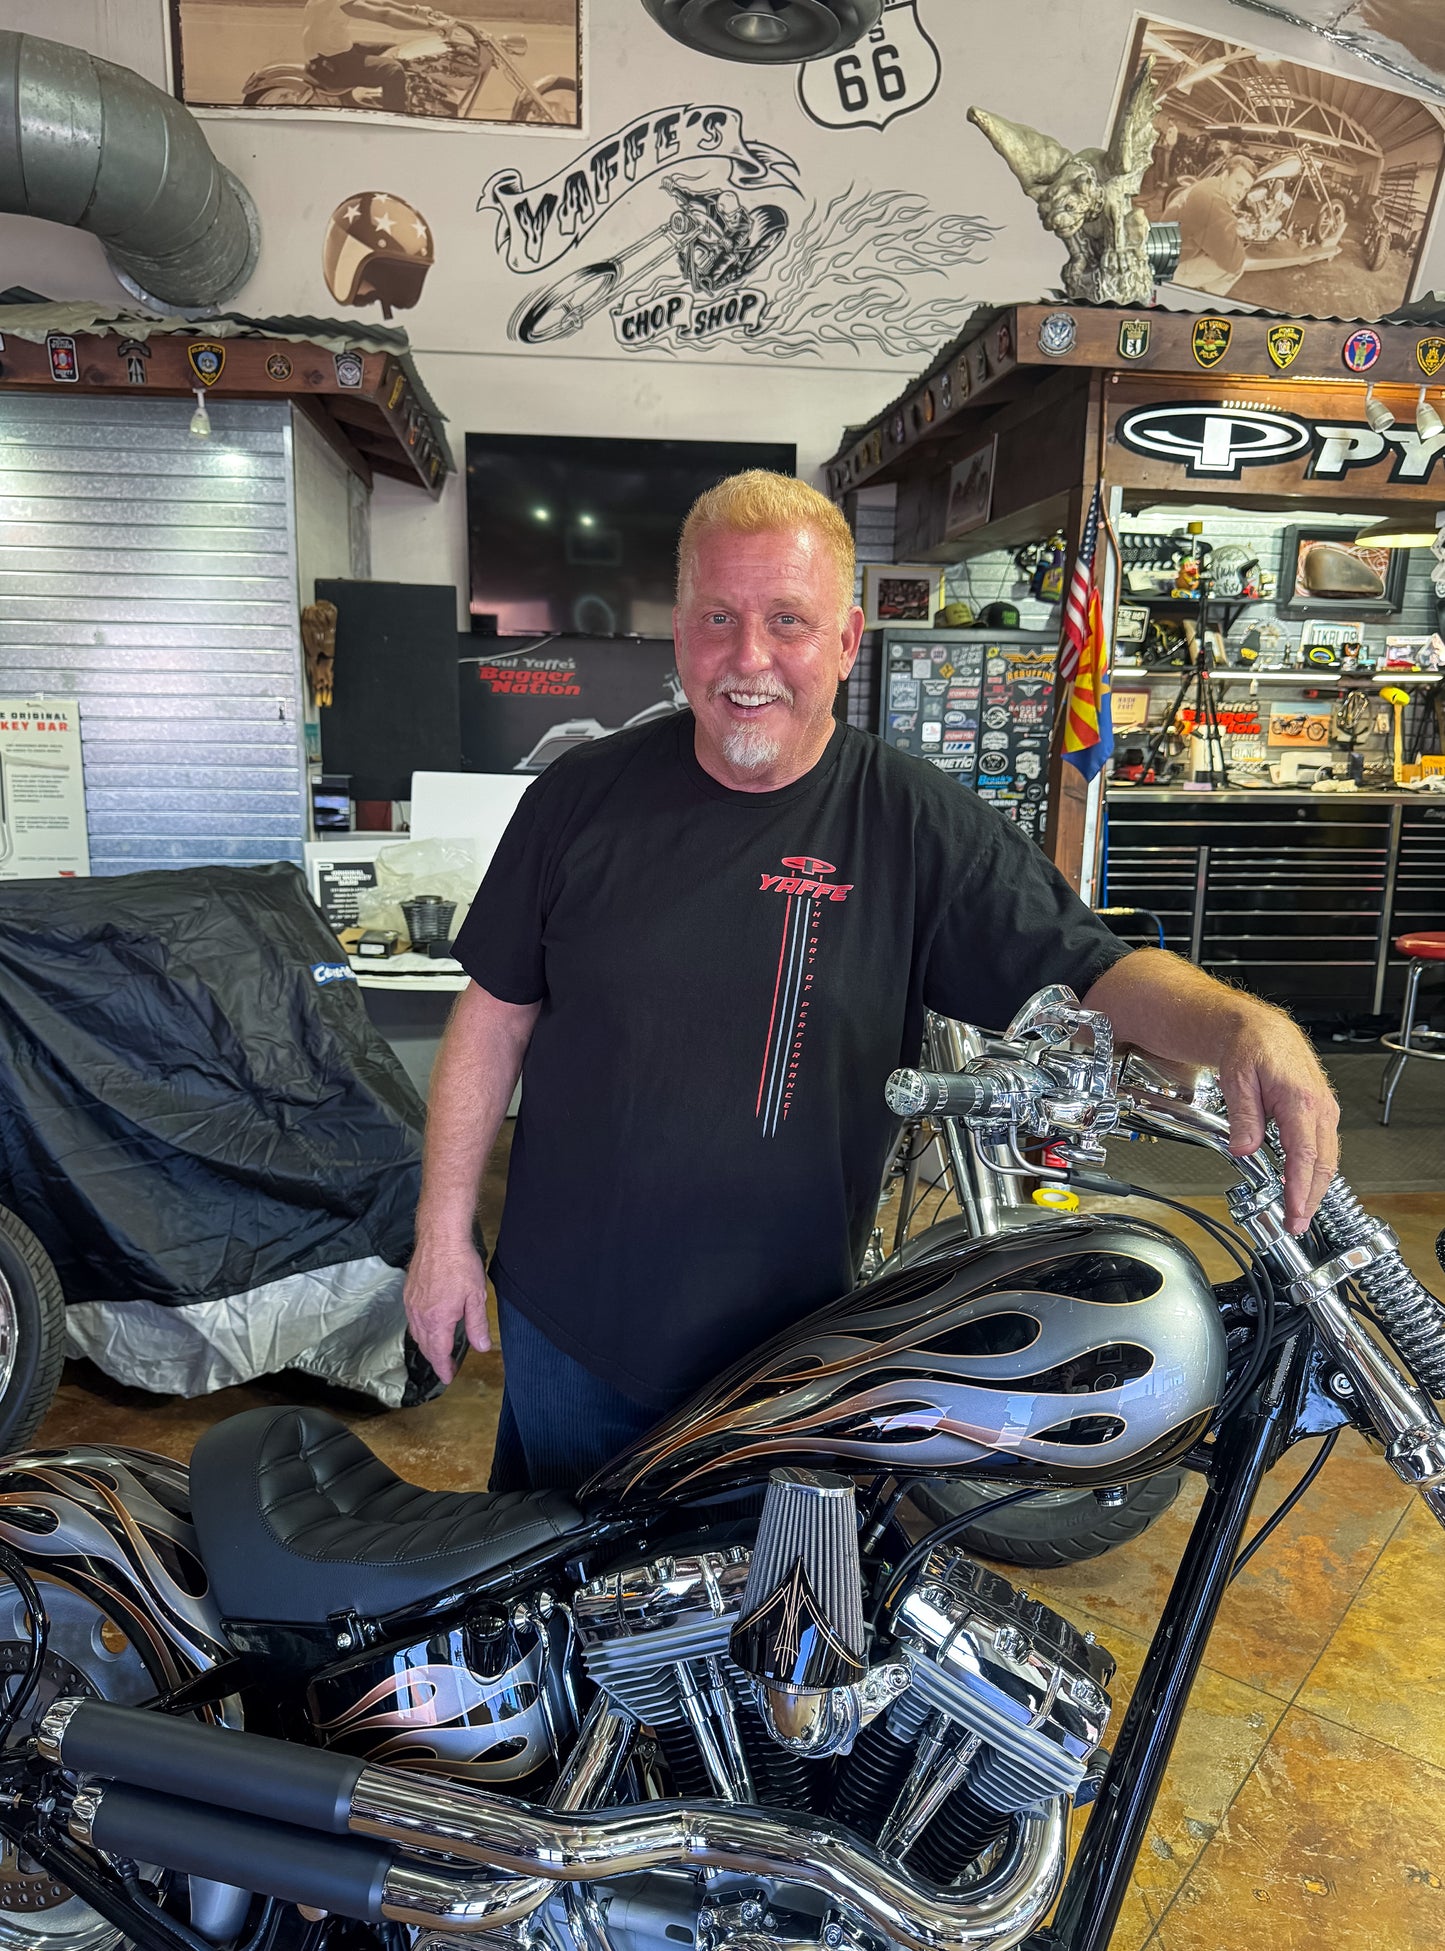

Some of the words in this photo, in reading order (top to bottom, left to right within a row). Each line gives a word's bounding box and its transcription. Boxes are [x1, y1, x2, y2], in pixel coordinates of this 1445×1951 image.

[834, 44, 906, 112] 66
[514, 112, 727, 263] YAFFE'S
[621, 296, 684, 340] CHOP
[694, 293, 758, 335] SHOP
[479, 657, 518, 668] Paul
[523, 657, 576, 670] Yaffe's
[479, 666, 576, 683] Bagger
[490, 680, 581, 696] Nation
[11, 712, 68, 721] ORIGINAL
[37, 722, 69, 732] BAR
[759, 873, 855, 902] YAFFE
[812, 900, 822, 928] THE
[808, 937, 819, 964] ART
[803, 974, 814, 991] OF
[783, 1001, 811, 1110] PERFORMANCE
